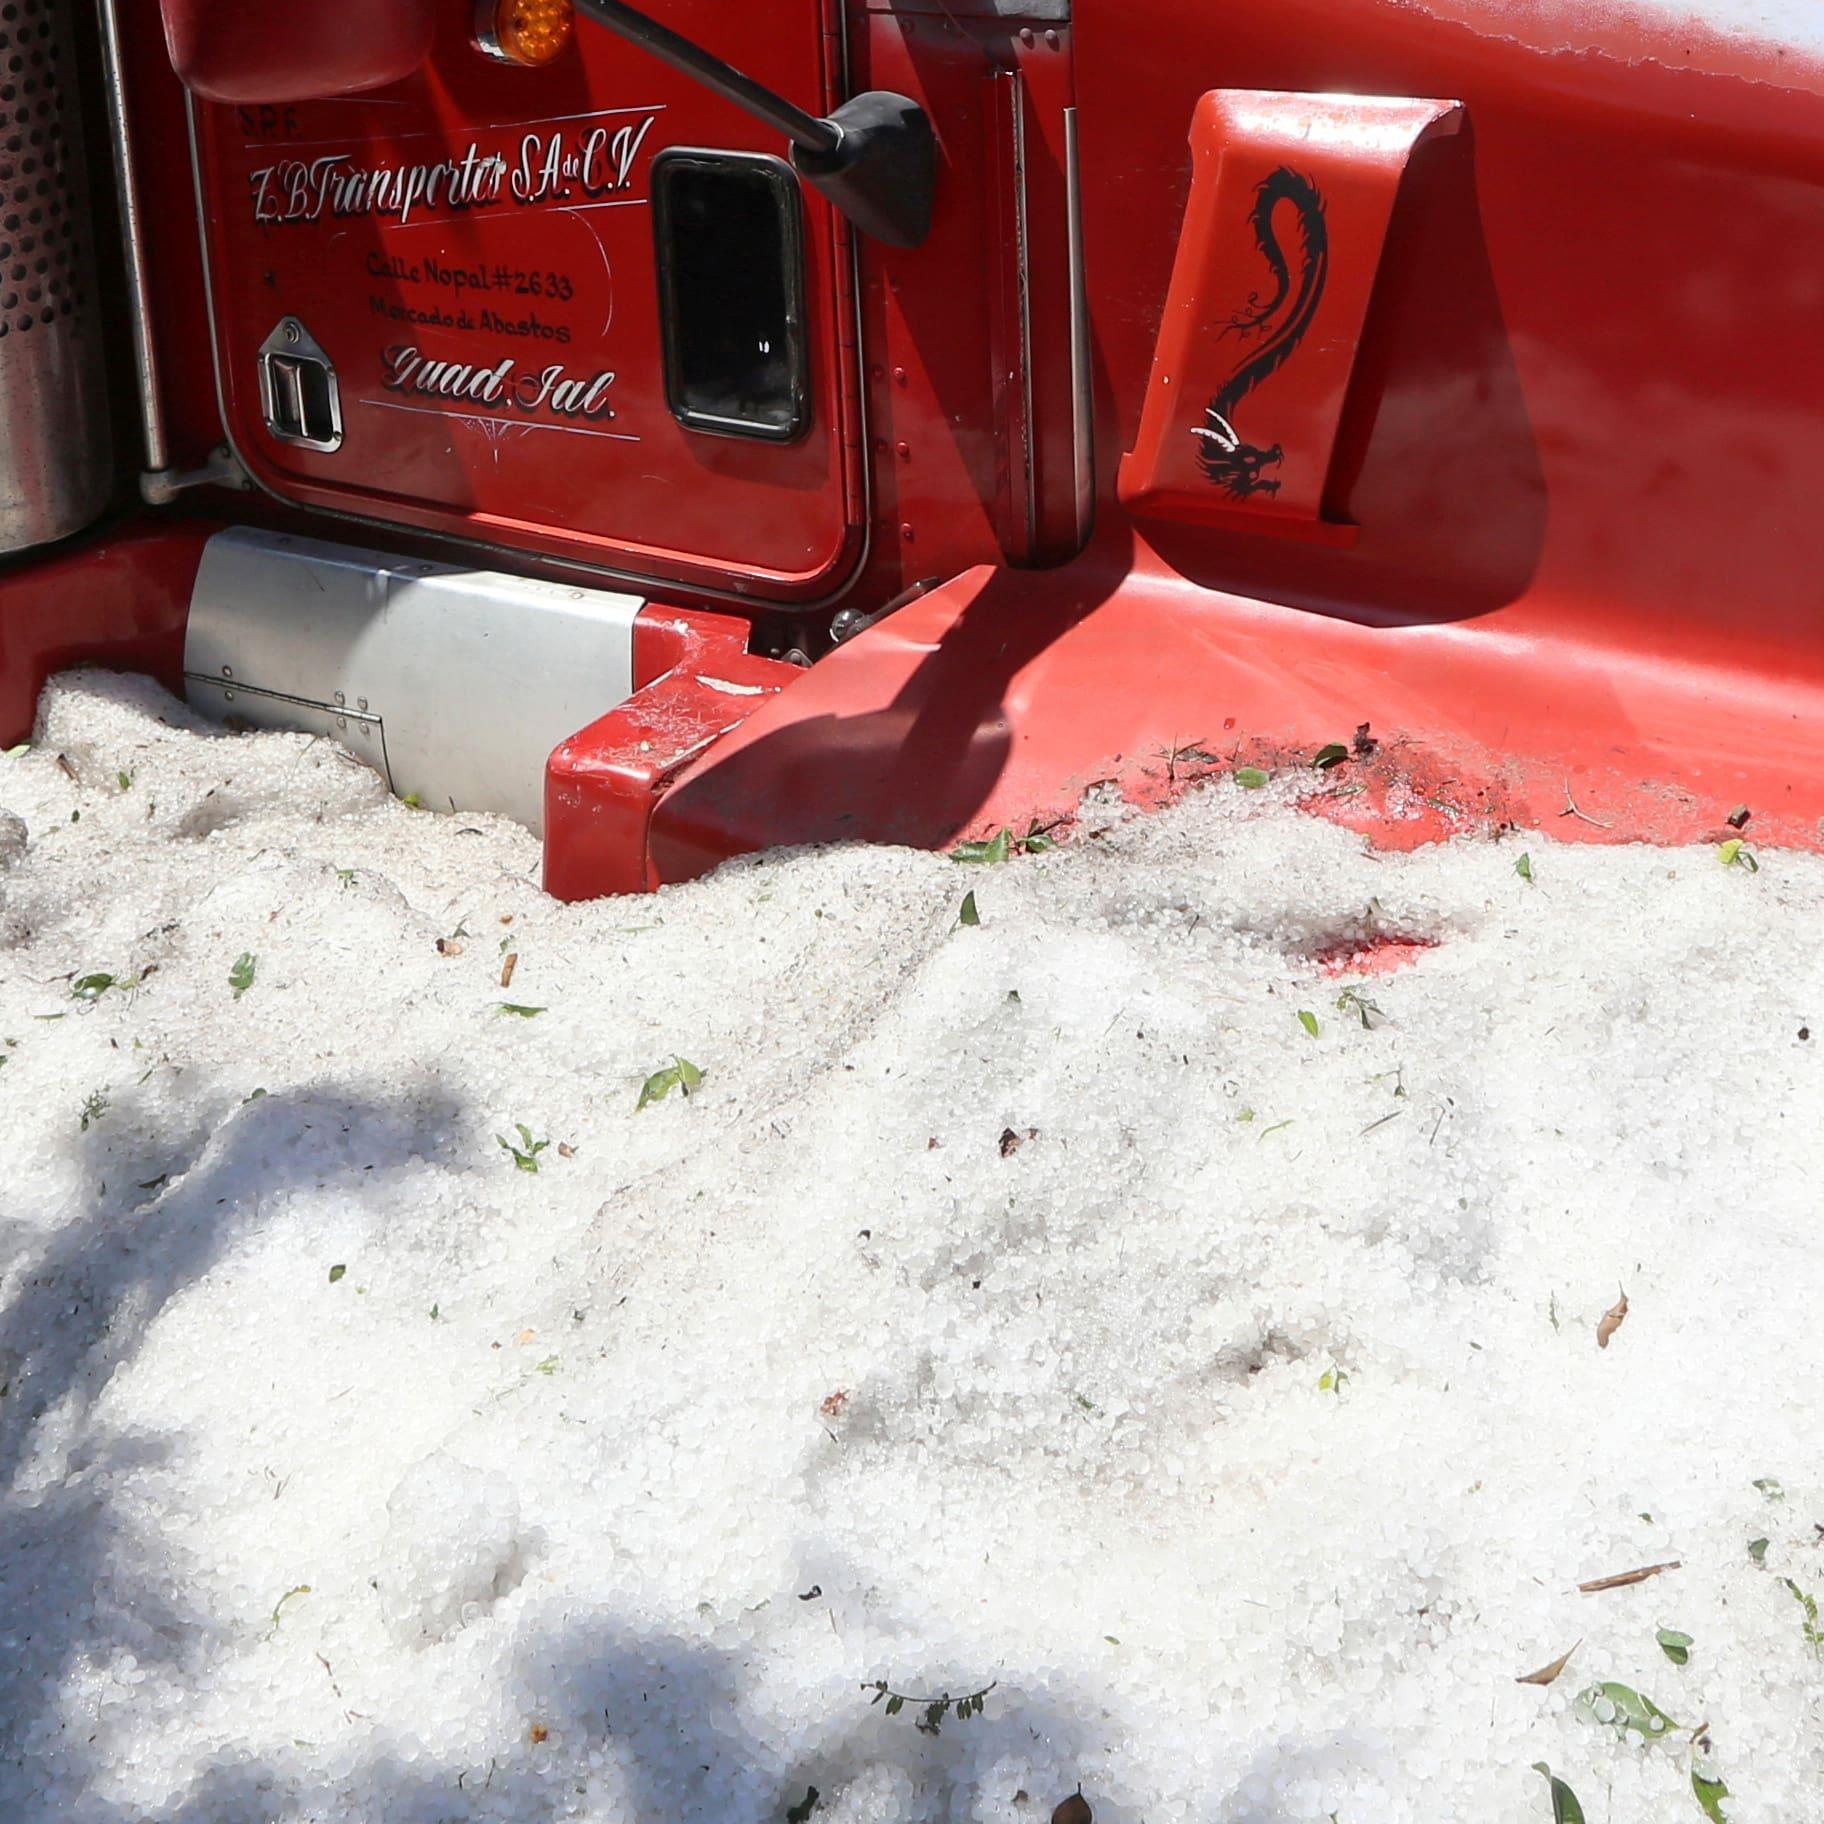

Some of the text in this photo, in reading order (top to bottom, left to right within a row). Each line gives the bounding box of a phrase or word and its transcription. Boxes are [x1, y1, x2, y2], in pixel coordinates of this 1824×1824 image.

[366, 252, 420, 283] Calle
[422, 256, 491, 298] Nopal
[479, 309, 572, 344] Abastos
